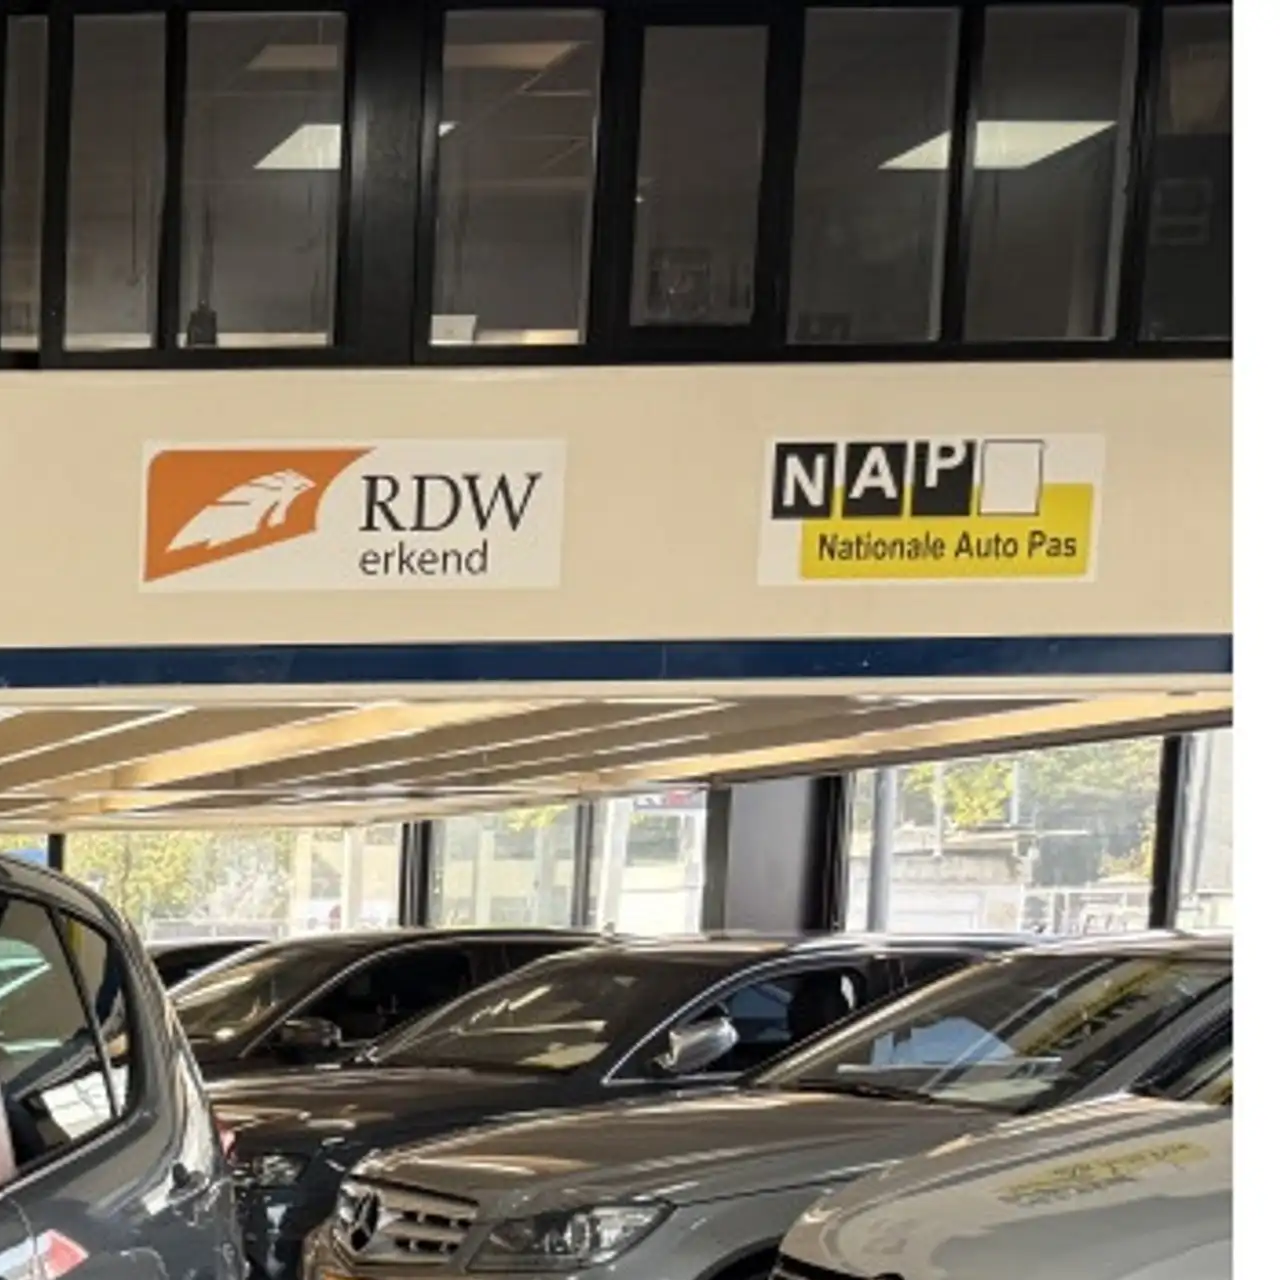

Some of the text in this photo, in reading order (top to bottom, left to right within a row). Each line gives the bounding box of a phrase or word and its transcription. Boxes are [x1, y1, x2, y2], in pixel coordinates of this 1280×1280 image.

[782, 440, 968, 507] NAP
[358, 470, 543, 533] RDW
[358, 537, 490, 577] erkend
[817, 529, 1078, 562] Nationale Auto Pas
